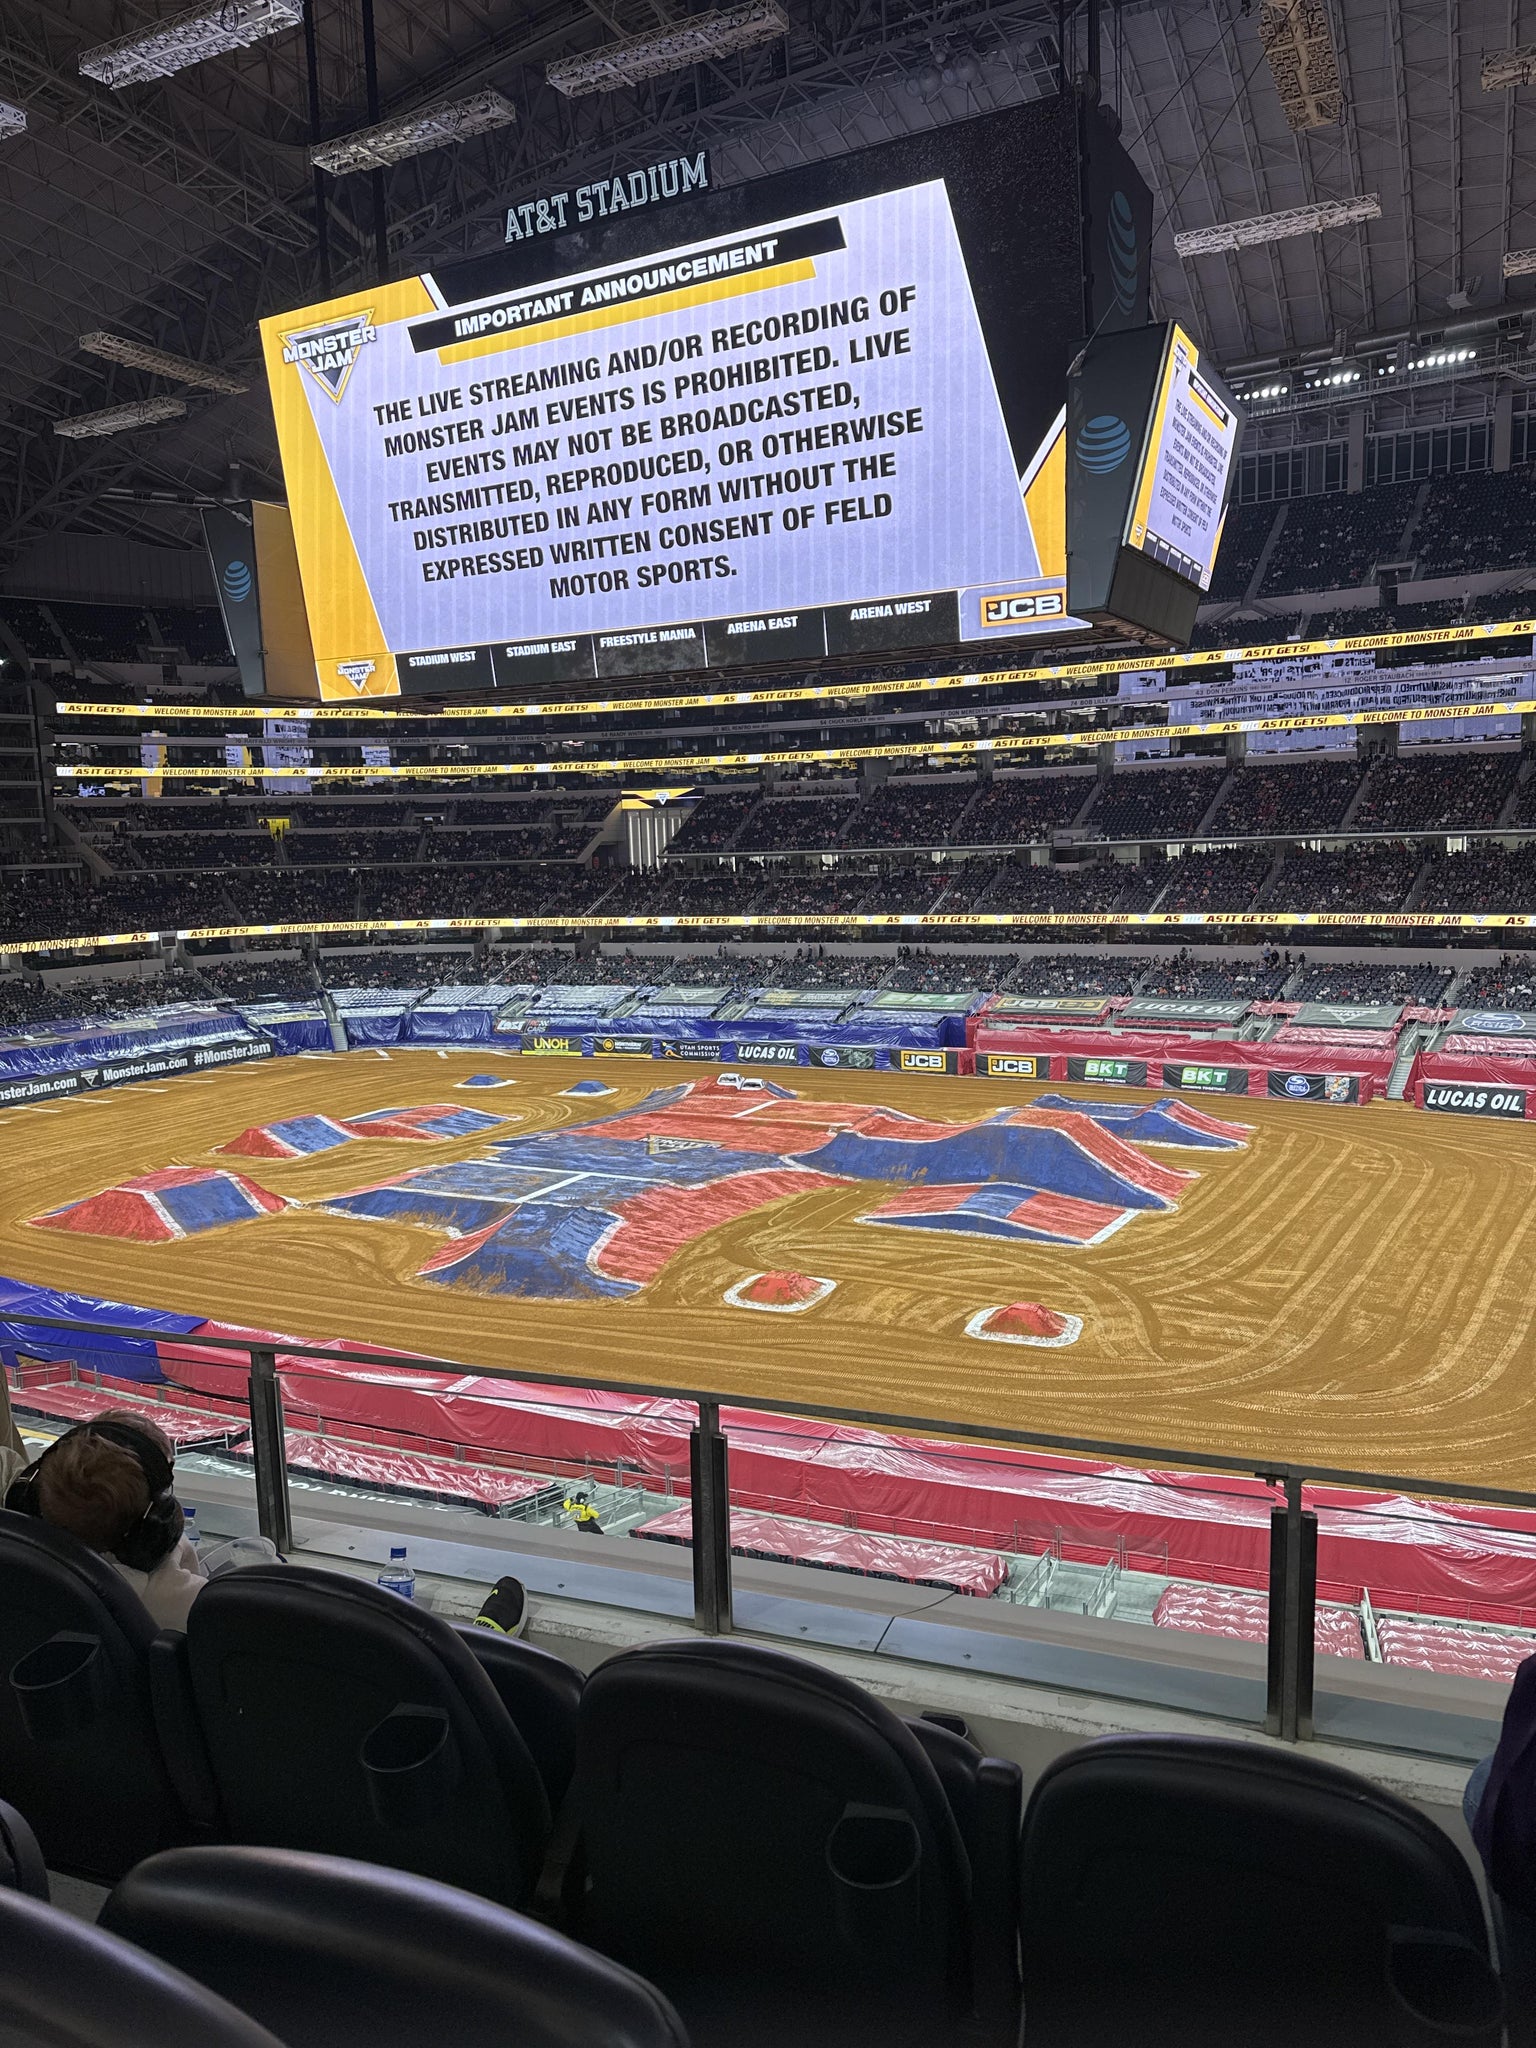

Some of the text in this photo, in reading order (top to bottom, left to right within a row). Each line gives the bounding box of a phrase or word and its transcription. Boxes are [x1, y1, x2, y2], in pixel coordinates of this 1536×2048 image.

[505, 152, 708, 243] AT&T STADIUM
[454, 240, 778, 337] IMPORTANT ANNOUNCEMENT
[282, 325, 377, 364] MONSTER
[309, 350, 354, 373] JAM
[374, 285, 916, 426] THE LIVE STREAMING AND/OR RECORDING OF
[384, 328, 911, 457] MONSTER JAM EVENTS IS PROHIBITED. LIVE
[426, 381, 860, 483] EVENTS MAY NOT BE BROADCASTED,
[388, 407, 923, 522] TRANSMITTED, REPRODUCED, OR OTHERWISE
[413, 452, 896, 551] DISTRIBUTED IN ANY FORM WITHOUT THE
[422, 493, 893, 582] EXPRESSED WRITTEN CONSENT OF FELD
[549, 555, 737, 599] MOTOR SPORTS.
[850, 600, 931, 621] ARENA WEST
[987, 595, 1062, 621] JCB
[728, 616, 798, 635] ARENA EAST
[1513, 623, 1531, 632] AS
[600, 627, 696, 648] FREESTYLE MANIA
[1345, 629, 1474, 649] WELCOME TO MONSTER JAM
[506, 640, 577, 657] STADIUM EAST
[1207, 653, 1221, 661] AS
[1245, 649, 1260, 658] AS
[1262, 649, 1274, 657] IT
[1276, 644, 1310, 656] GETS!
[409, 650, 476, 667] STADIUM WEST
[1066, 657, 1174, 675] WELCOME TO MONSTER JAM
[949, 677, 961, 685] AS
[981, 674, 994, 682] AS
[1009, 671, 1036, 680] GETS!
[97, 706, 125, 714] GETS!
[653, 699, 683, 707] MONSTER
[685, 697, 699, 705] JAM
[203, 708, 237, 716] MONSTER
[1363, 705, 1494, 722] WELCOME TO MONSTER JAM
[1223, 723, 1238, 731] AS
[1262, 720, 1277, 728] AS
[1279, 719, 1291, 727] IT
[1294, 717, 1327, 726] GETS!
[1022, 737, 1050, 745] GETS!
[1081, 726, 1190, 741] WELCOME TO MONSTER JAM
[484, 765, 498, 773] JAM
[1012, 915, 1129, 924] WELCOME TO MONSTER JAM
[1206, 915, 1278, 923] AS IT GETS!
[1318, 915, 1461, 925] WELCOME TO MONSTER JAM
[1132, 1002, 1241, 1015] LUCAS OIL
[534, 1038, 568, 1049] UNOH
[103, 1041, 271, 1081] MonsterJam.com #MonsterJam
[738, 1046, 776, 1059] LUCAS
[904, 1054, 942, 1068] JCB
[991, 1059, 1033, 1074] JCB
[1086, 1062, 1128, 1076] BKT
[1183, 1069, 1228, 1083] BKT
[1426, 1089, 1488, 1109] LUCAS
